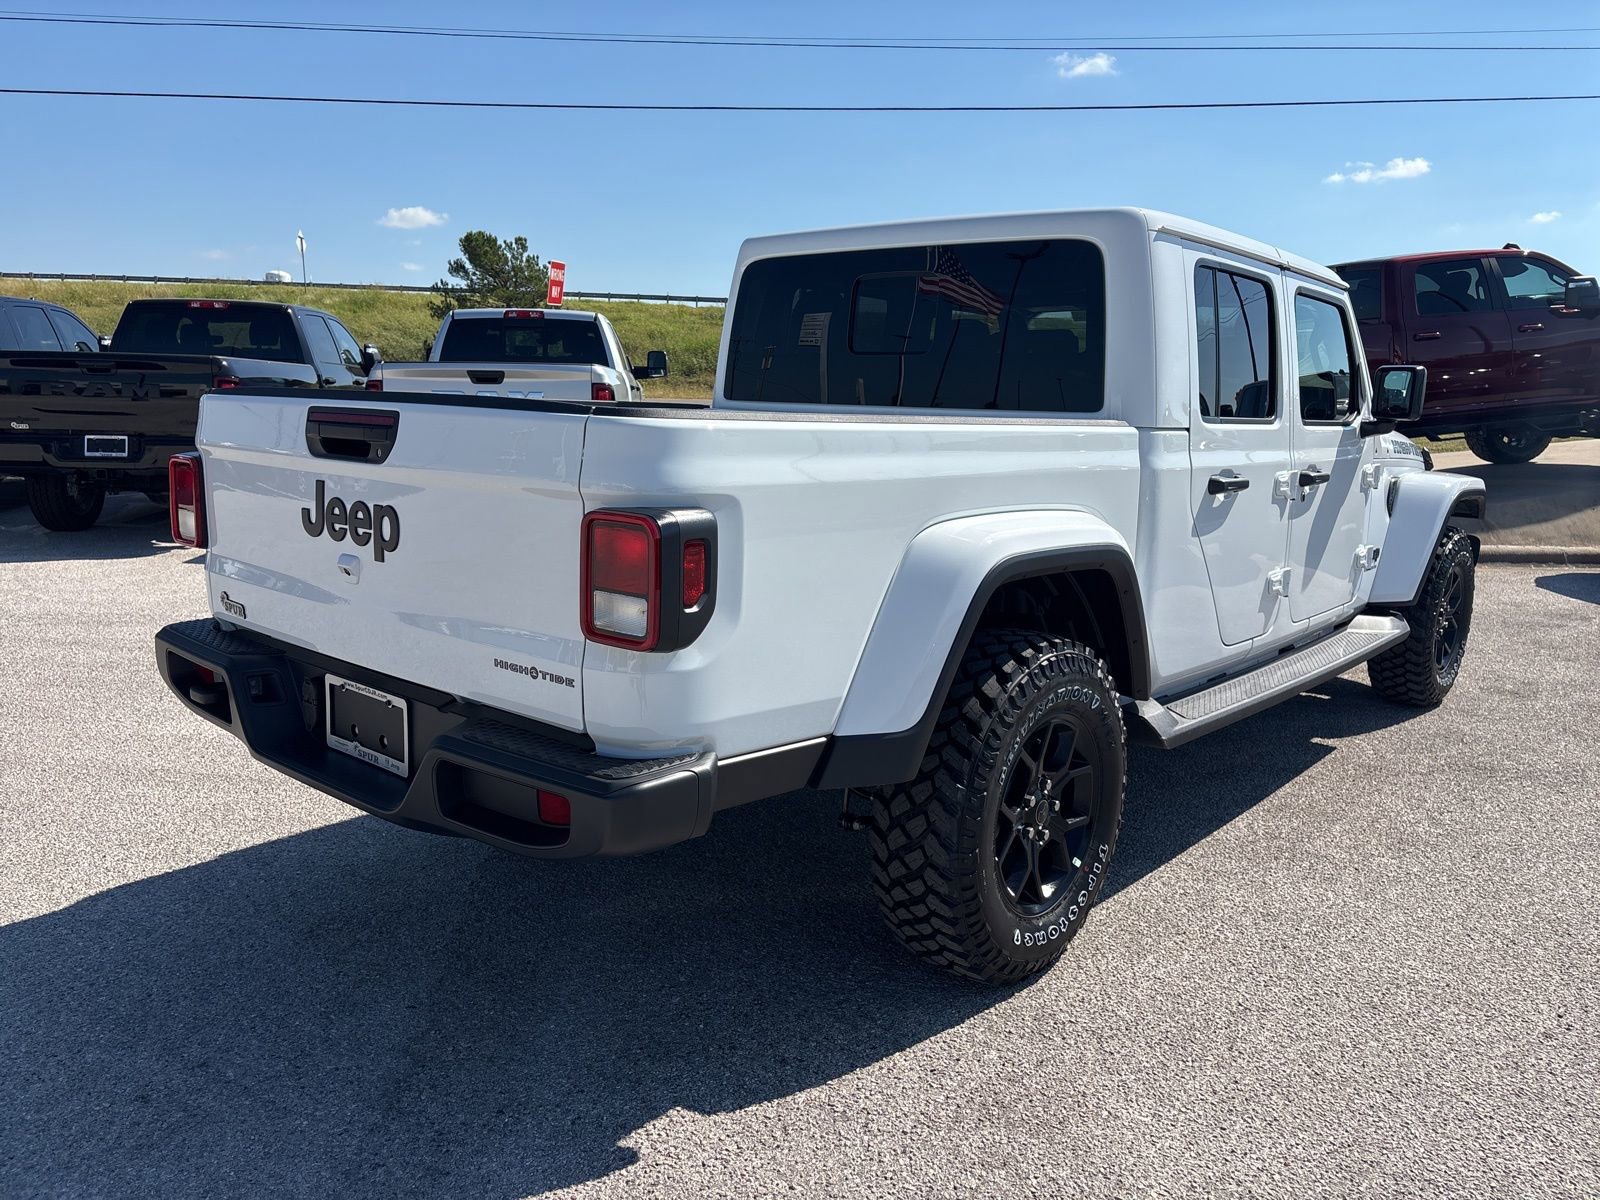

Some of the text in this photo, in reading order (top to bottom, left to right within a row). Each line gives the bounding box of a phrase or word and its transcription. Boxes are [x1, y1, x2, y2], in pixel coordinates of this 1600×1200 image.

[551, 267, 564, 281] WRONG
[551, 285, 561, 298] WAY
[40, 381, 160, 398] RAM
[301, 479, 400, 563] Jeep
[224, 601, 244, 618] SPUR
[493, 658, 575, 688] HIGH TIDE
[357, 749, 379, 764] SPUR
